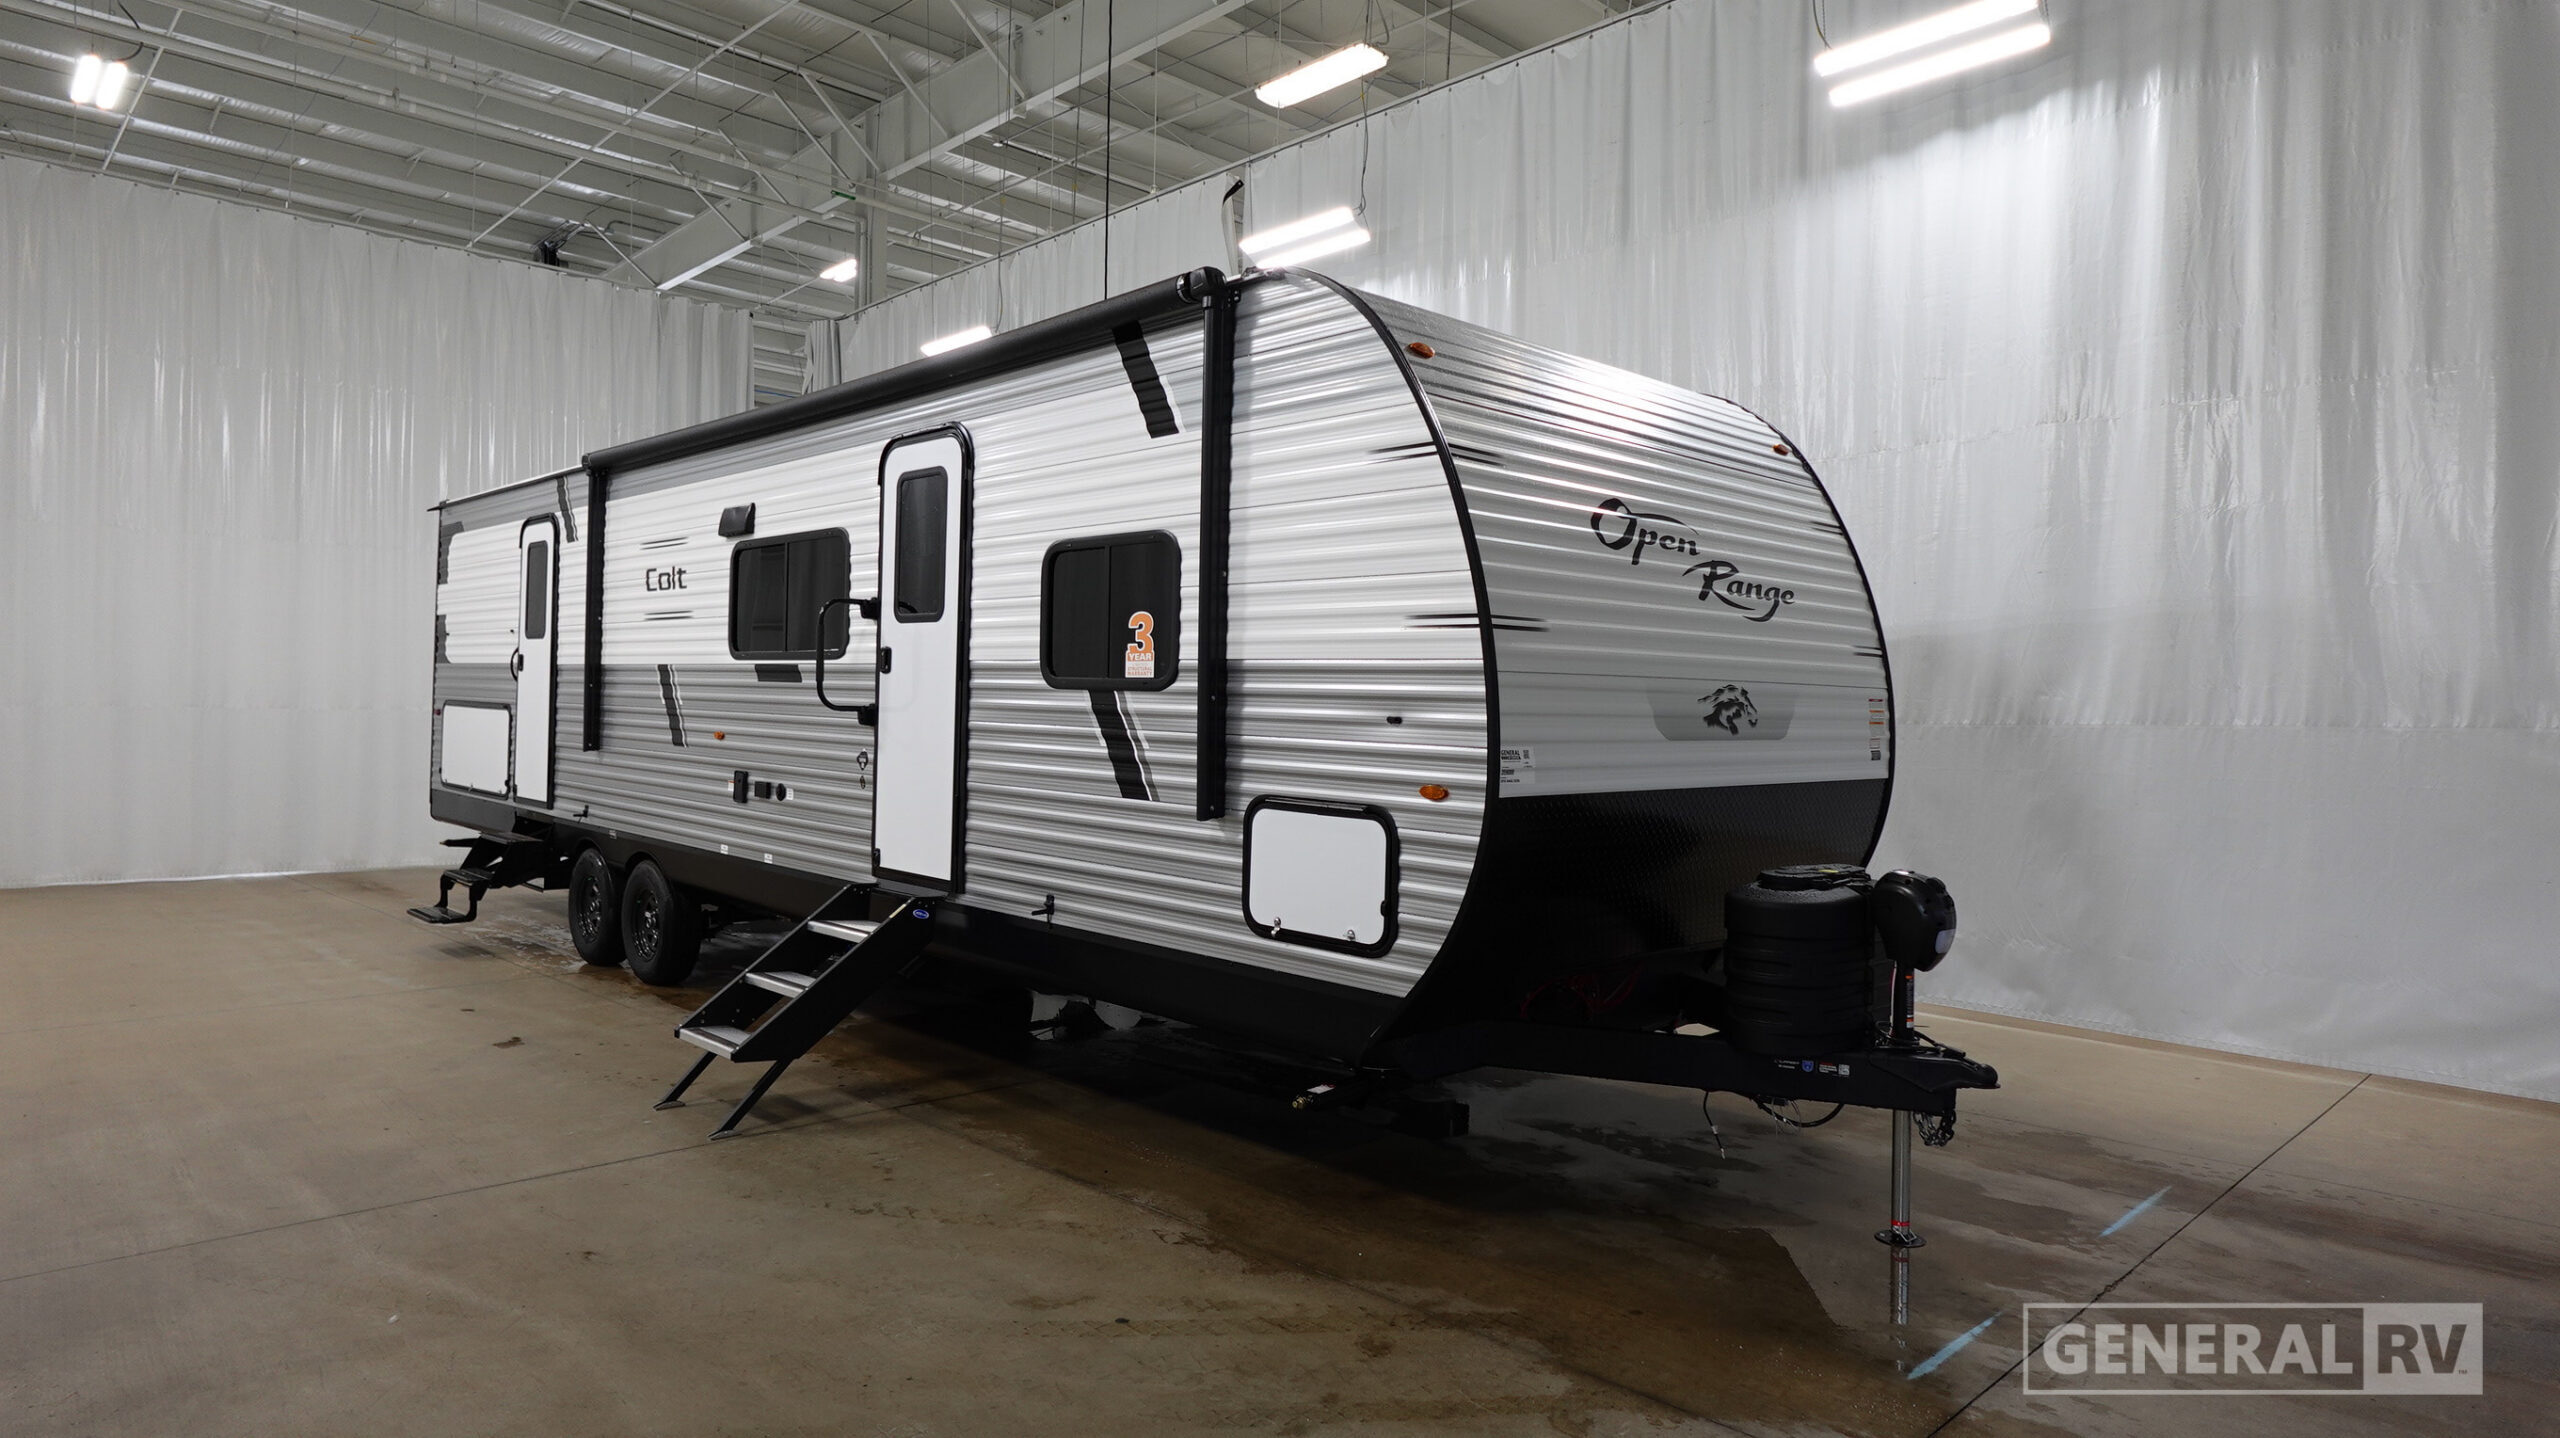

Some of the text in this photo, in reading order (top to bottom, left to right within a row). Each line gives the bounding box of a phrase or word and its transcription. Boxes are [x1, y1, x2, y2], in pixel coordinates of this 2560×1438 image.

[1590, 498, 1700, 565] Open
[645, 565, 688, 592] Colt
[1682, 560, 1796, 622] Range
[1127, 611, 1154, 653] 3
[1128, 652, 1152, 661] YEAR
